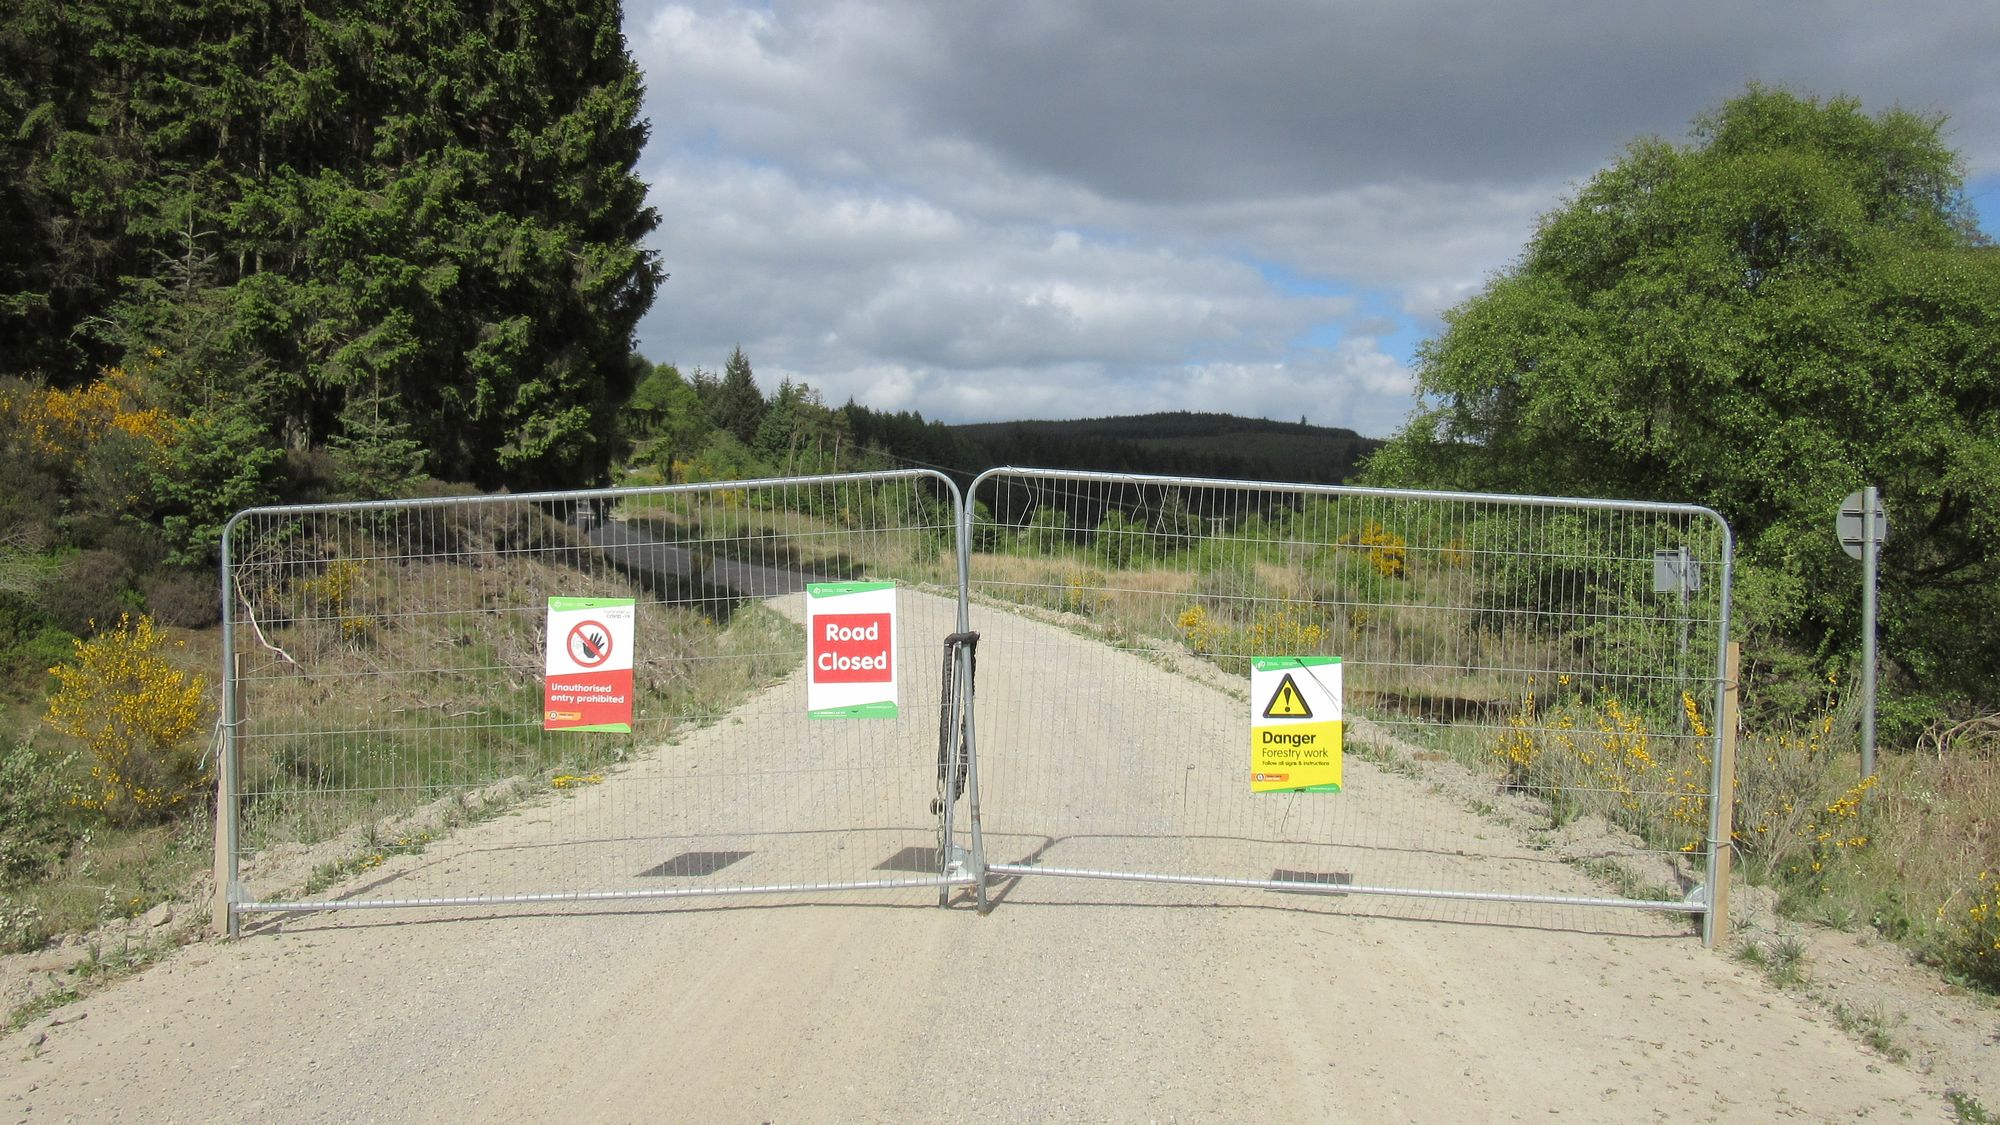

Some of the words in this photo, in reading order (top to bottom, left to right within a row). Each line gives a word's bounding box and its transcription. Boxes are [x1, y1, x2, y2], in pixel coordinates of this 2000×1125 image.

[826, 621, 878, 641] Road
[818, 650, 887, 671] Closed
[551, 683, 612, 693] Unauthorised
[551, 694, 574, 704] entry
[576, 694, 625, 704] prohibited
[1262, 731, 1317, 747] Danger
[1262, 747, 1301, 760] Forestry
[1303, 747, 1329, 758] work
